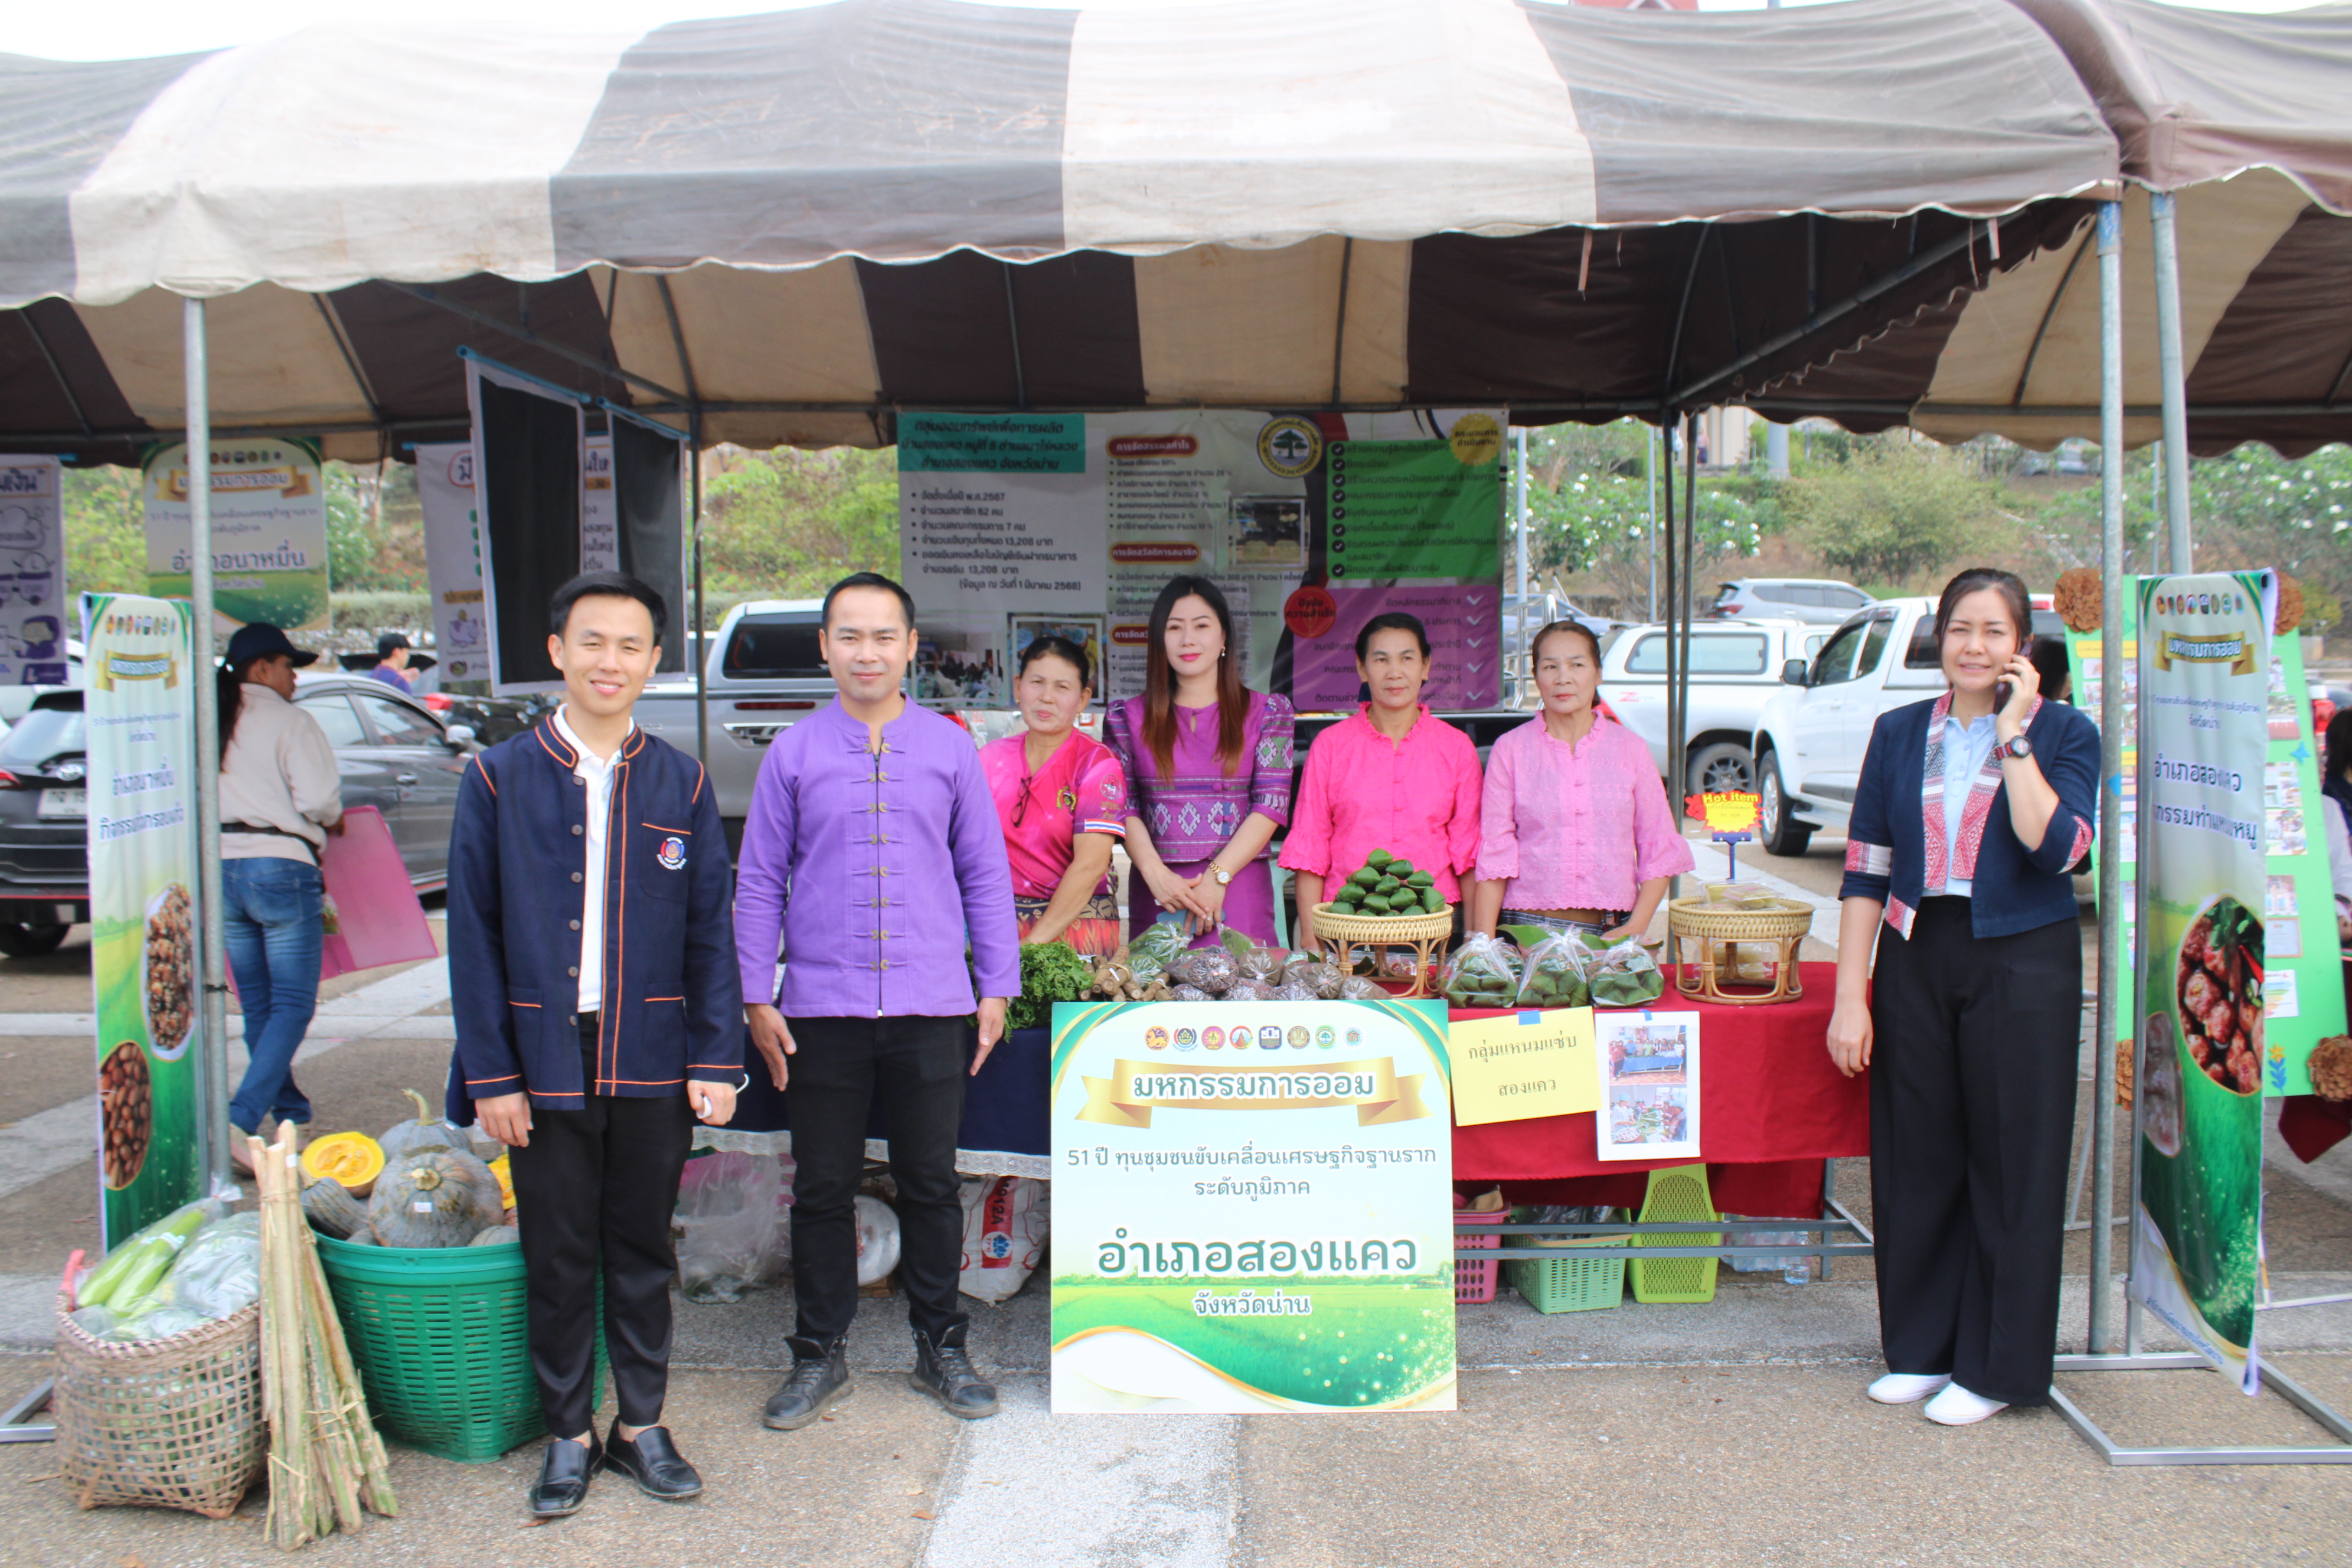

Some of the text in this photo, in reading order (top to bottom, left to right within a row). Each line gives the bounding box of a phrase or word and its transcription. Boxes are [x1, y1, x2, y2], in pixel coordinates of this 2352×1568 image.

[988, 441, 997, 451] 5
[921, 455, 997, 469] อำเภอสองแคว
[178, 473, 289, 486] มรรมการออม
[920, 505, 976, 517] จำนวนสมาชิก
[991, 508, 1004, 517] คน
[920, 520, 1026, 532] จำนวนคณะกรรมการ 7 คน
[1036, 538, 1054, 546] บาท
[923, 563, 965, 574] จำนวนเงิน
[1001, 566, 1019, 574] บาท
[999, 577, 1017, 589] วันที่
[1024, 579, 1052, 590] มีนาคม
[1115, 630, 1149, 639] การจัดสว
[1314, 640, 1462, 652] สมาชิกทุก ประจำปี
[1324, 665, 1357, 674] คณะกรร
[1703, 792, 1759, 803] Hot item
[1468, 1030, 1577, 1063] กลุ่มแหนมแซ่บ
[1133, 1073, 1374, 1099] มหกรรมการออม
[1498, 1077, 1557, 1096] สองแคว
[1067, 1140, 1437, 1172] 51 ปี ทุนชุมชนขับเคลื่อนเศรษฐกิจฐานราก
[1194, 1176, 1311, 1201] ระดับภูมิภาค
[1097, 1227, 1417, 1273] อำเภอสองแคว
[1194, 1291, 1311, 1315] จังหวัดน่าน
